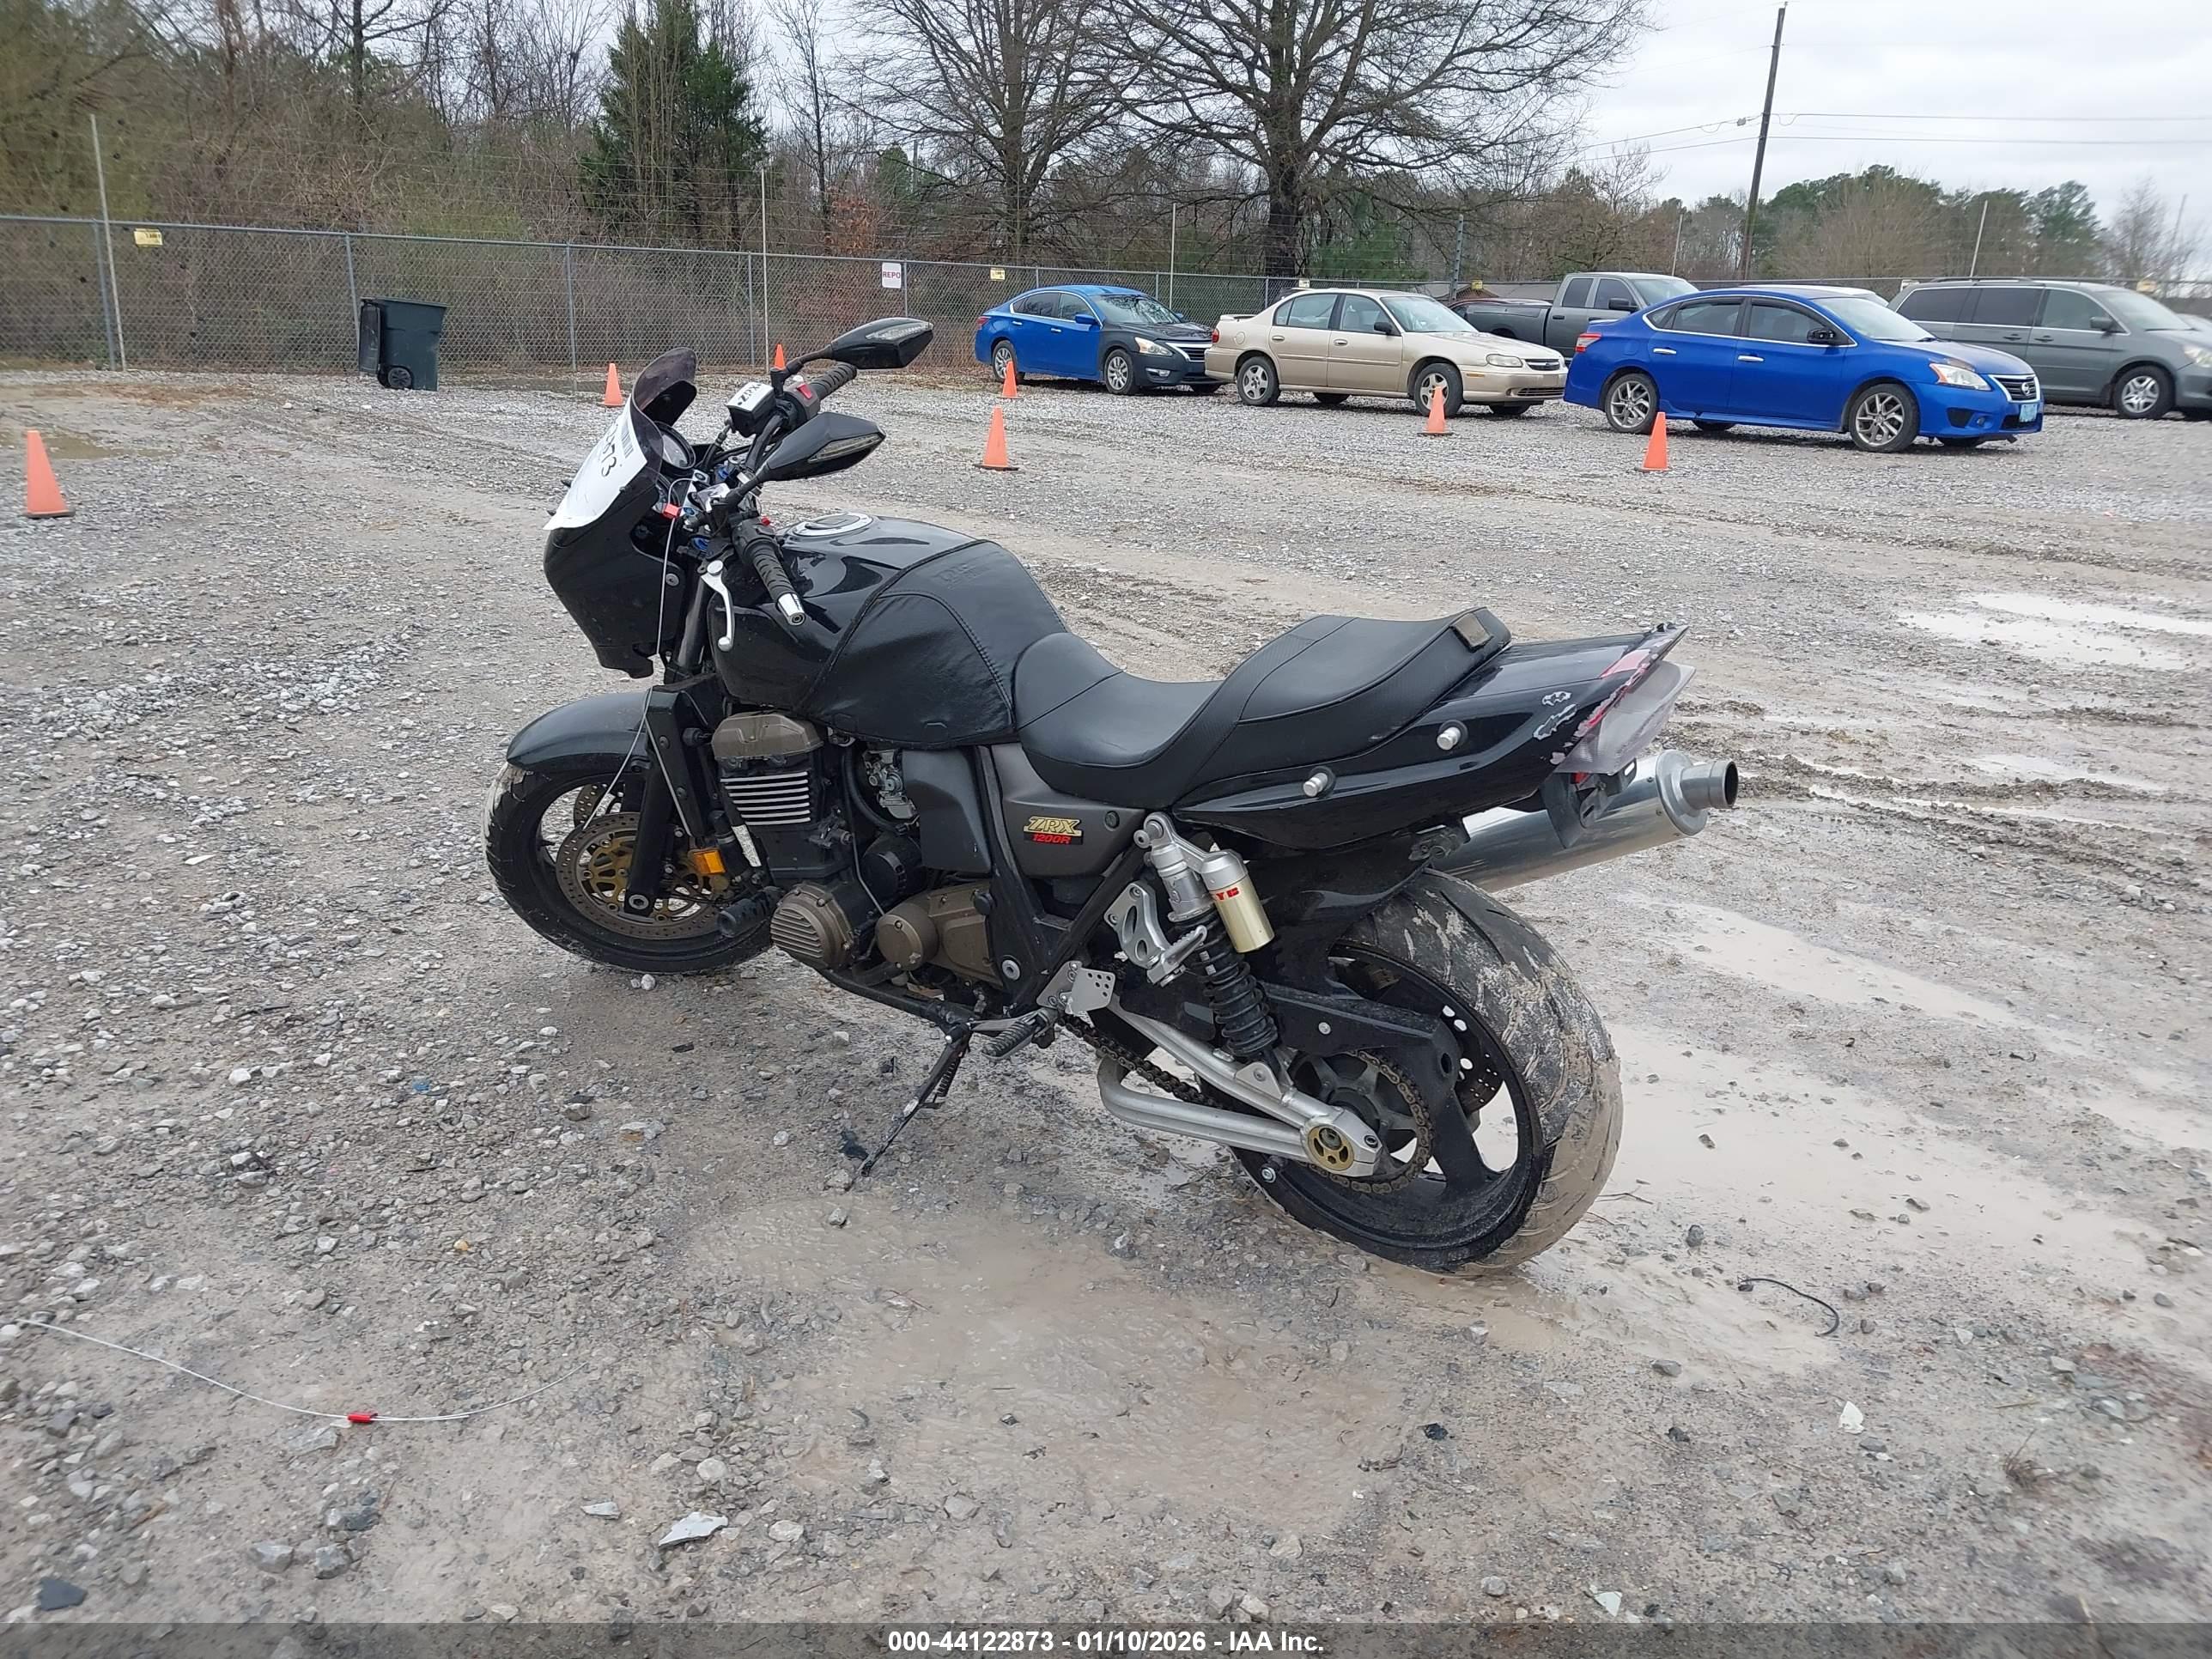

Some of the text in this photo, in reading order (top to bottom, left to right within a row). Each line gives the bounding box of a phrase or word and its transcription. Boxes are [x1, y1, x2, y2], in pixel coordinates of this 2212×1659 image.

[883, 270, 901, 279] REPO
[1026, 817, 1080, 836] ZRX
[1033, 834, 1072, 844] 1200R
[1215, 887, 1240, 901] YB
